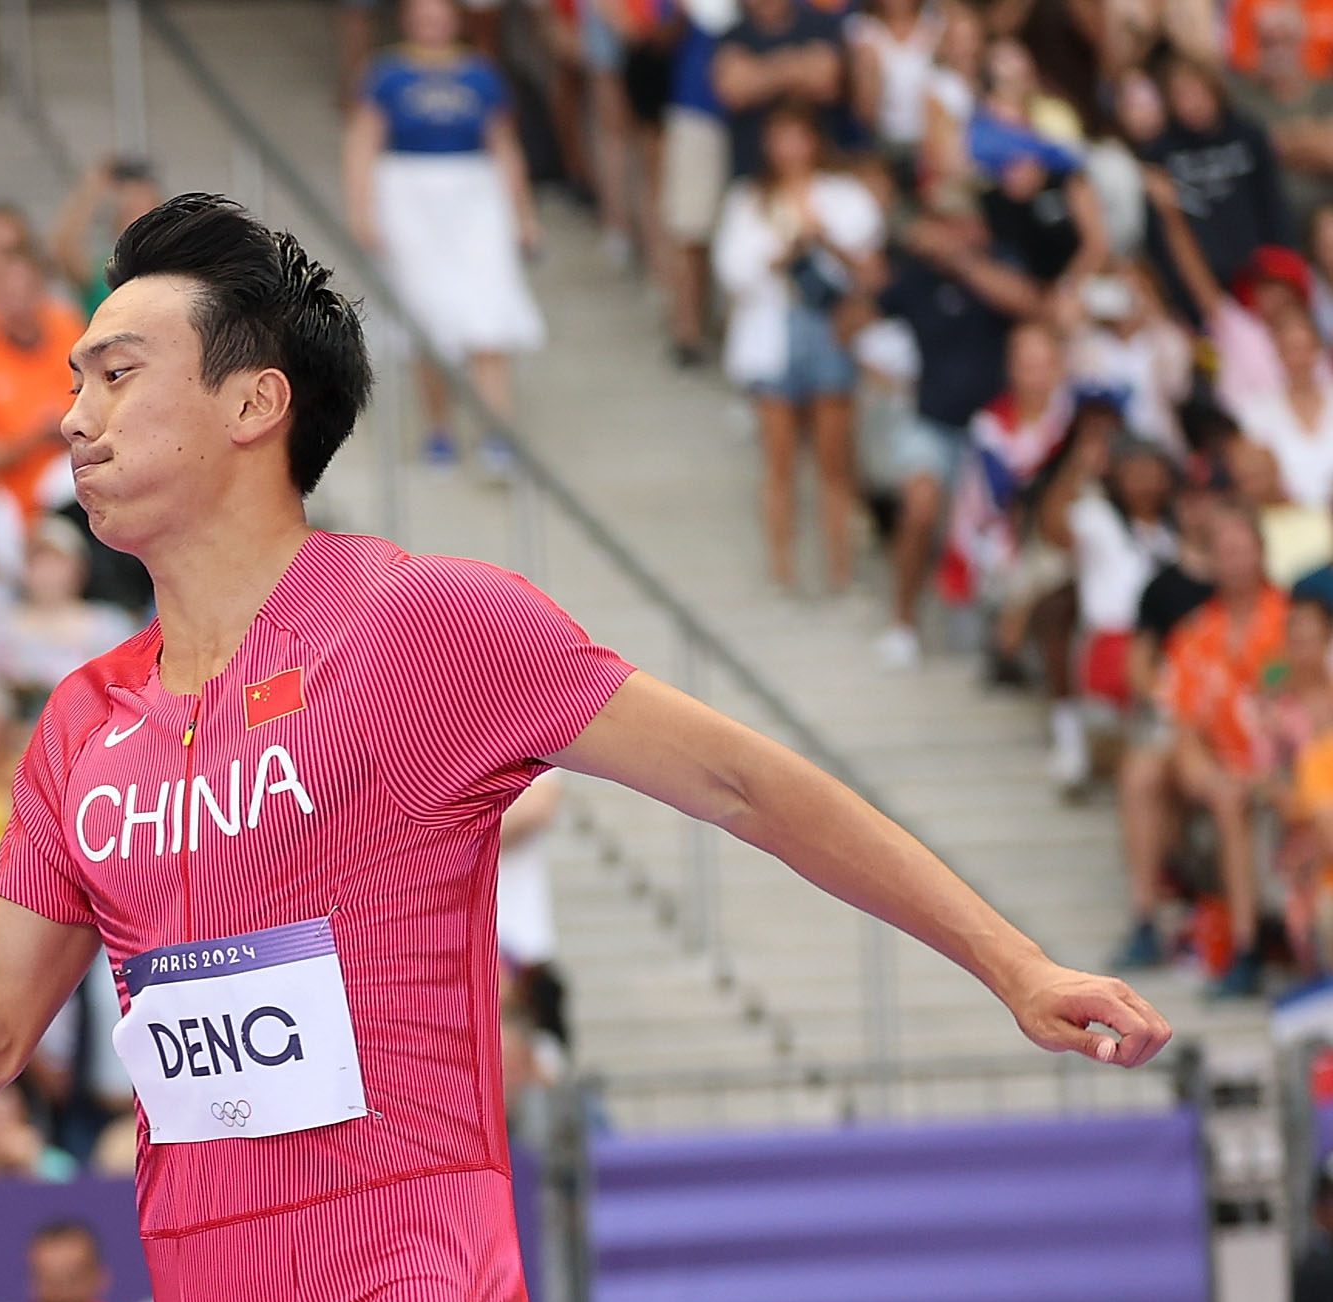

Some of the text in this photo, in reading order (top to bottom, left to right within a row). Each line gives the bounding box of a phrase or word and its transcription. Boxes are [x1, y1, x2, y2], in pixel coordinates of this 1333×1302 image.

[76, 744, 314, 863] CHINA
[201, 944, 256, 968] 2024
[147, 1005, 305, 1080] DENG
